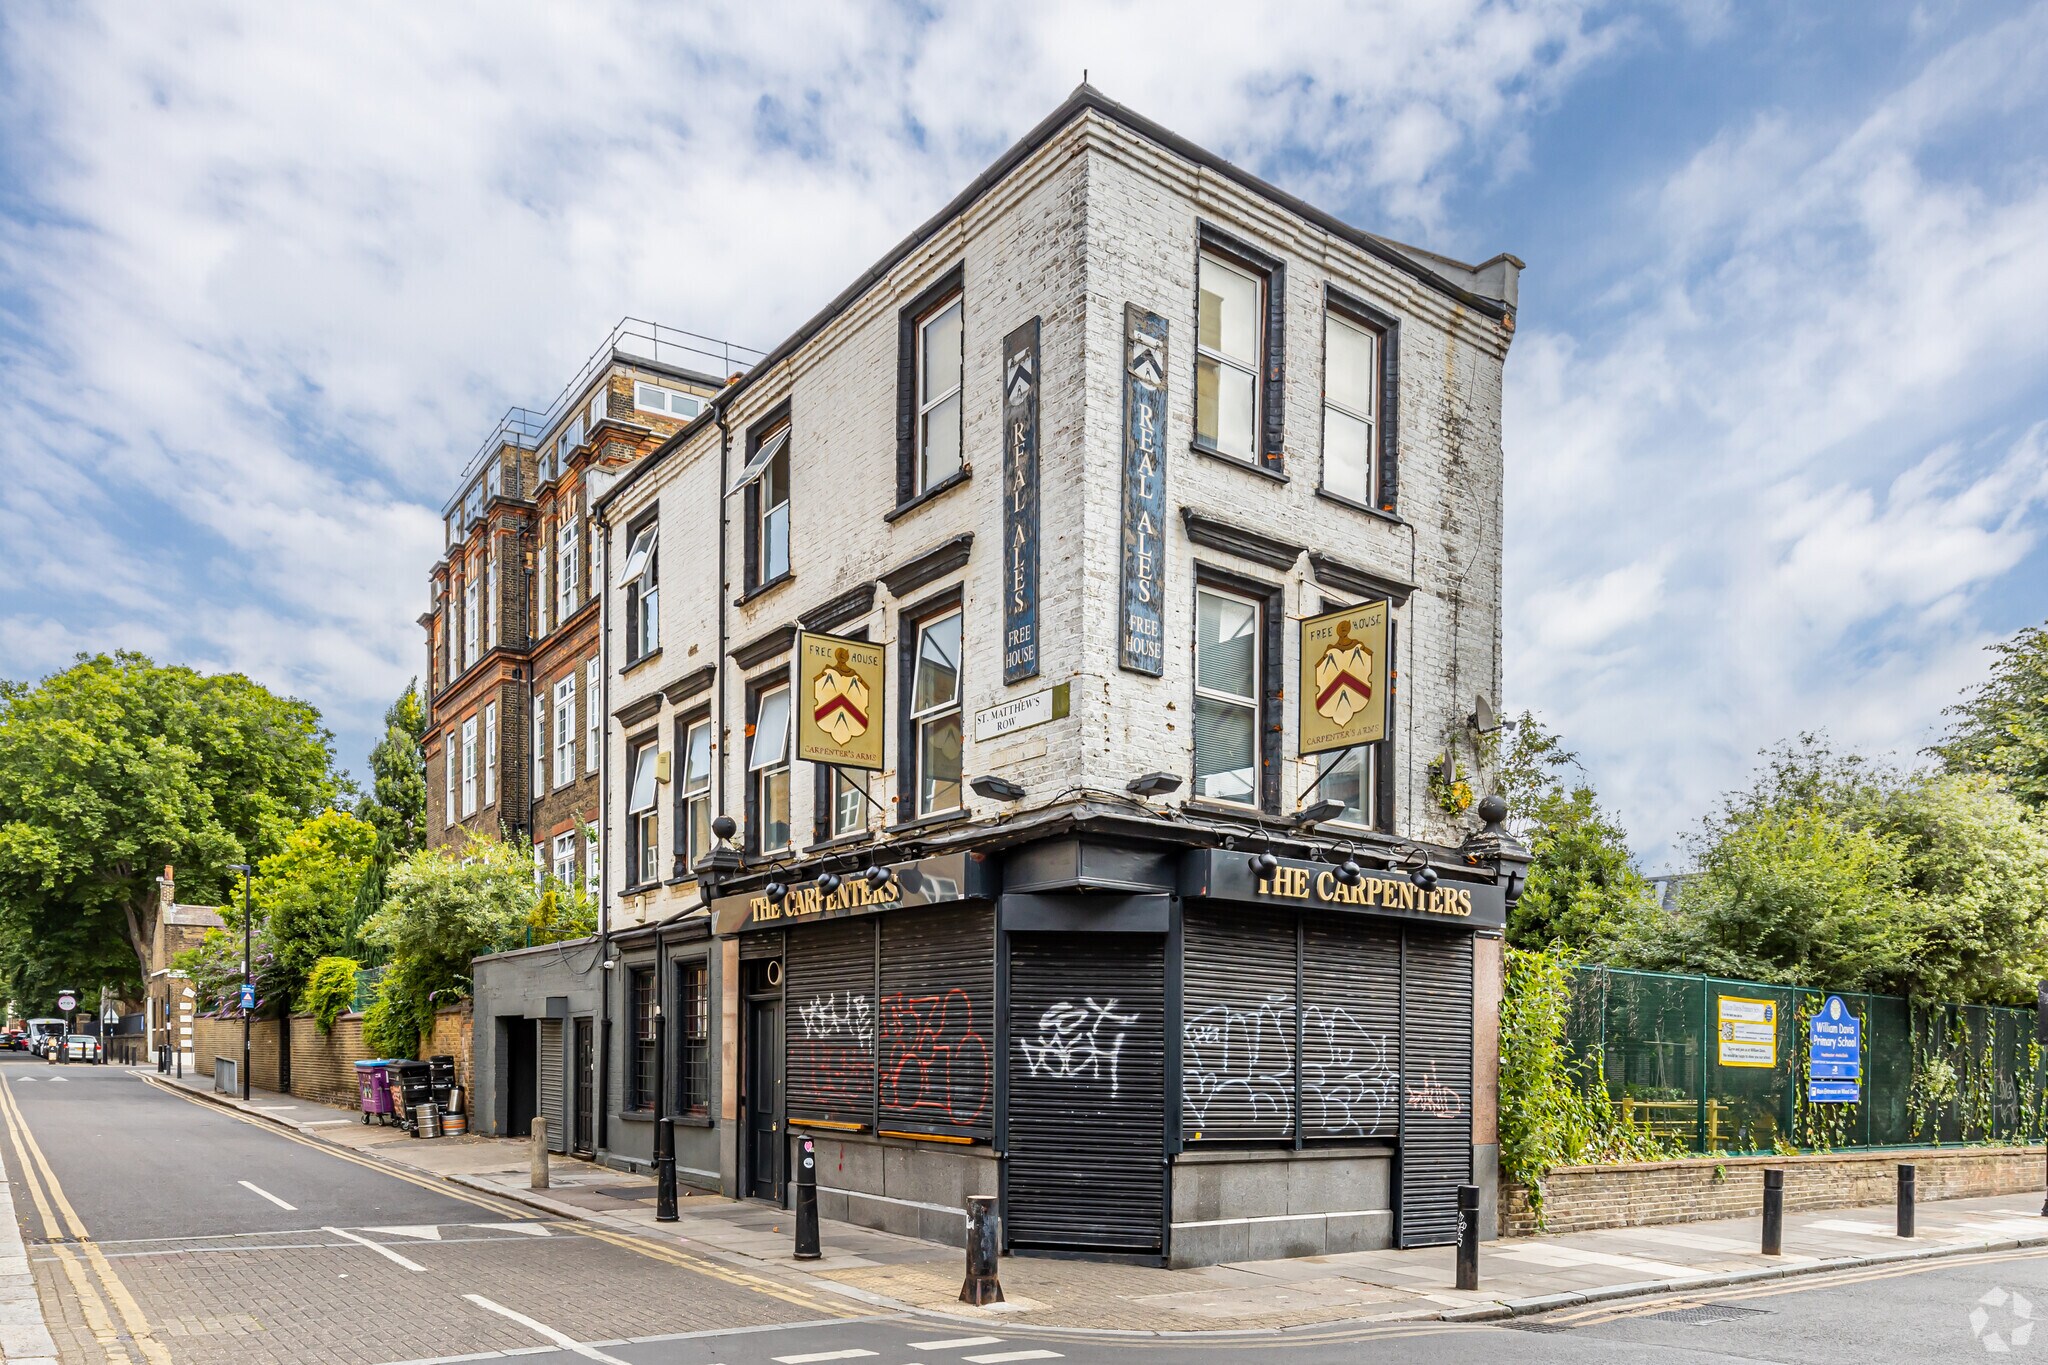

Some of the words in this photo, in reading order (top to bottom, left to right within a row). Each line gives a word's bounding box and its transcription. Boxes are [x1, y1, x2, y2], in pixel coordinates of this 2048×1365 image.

[1138, 403, 1155, 499] REAL
[1137, 510, 1153, 602] ALES
[1012, 523, 1026, 614] ALES
[1008, 624, 1031, 647] FREE
[1130, 614, 1158, 637] FREE
[1310, 626, 1333, 641] FREE
[1352, 613, 1382, 630] HOUSE
[809, 645, 832, 658] FREE
[851, 653, 879, 667] HOUSE
[1005, 644, 1034, 669] HOUSE
[1125, 634, 1162, 659] HOUSE
[977, 713, 989, 725] ST.
[991, 696, 1040, 721] MATTHEW'S
[997, 716, 1017, 731] ROW
[1306, 728, 1356, 746] CARPENTER'S
[1357, 724, 1380, 736] ARMS
[804, 745, 855, 759] CARPENTER'S
[855, 752, 877, 761] ARMS
[1316, 871, 1473, 917] CARPENTERS
[1816, 1021, 1838, 1034] William
[1838, 1022, 1855, 1035] Davis
[1813, 1035, 1836, 1050] Primary
[1837, 1036, 1857, 1048] School
